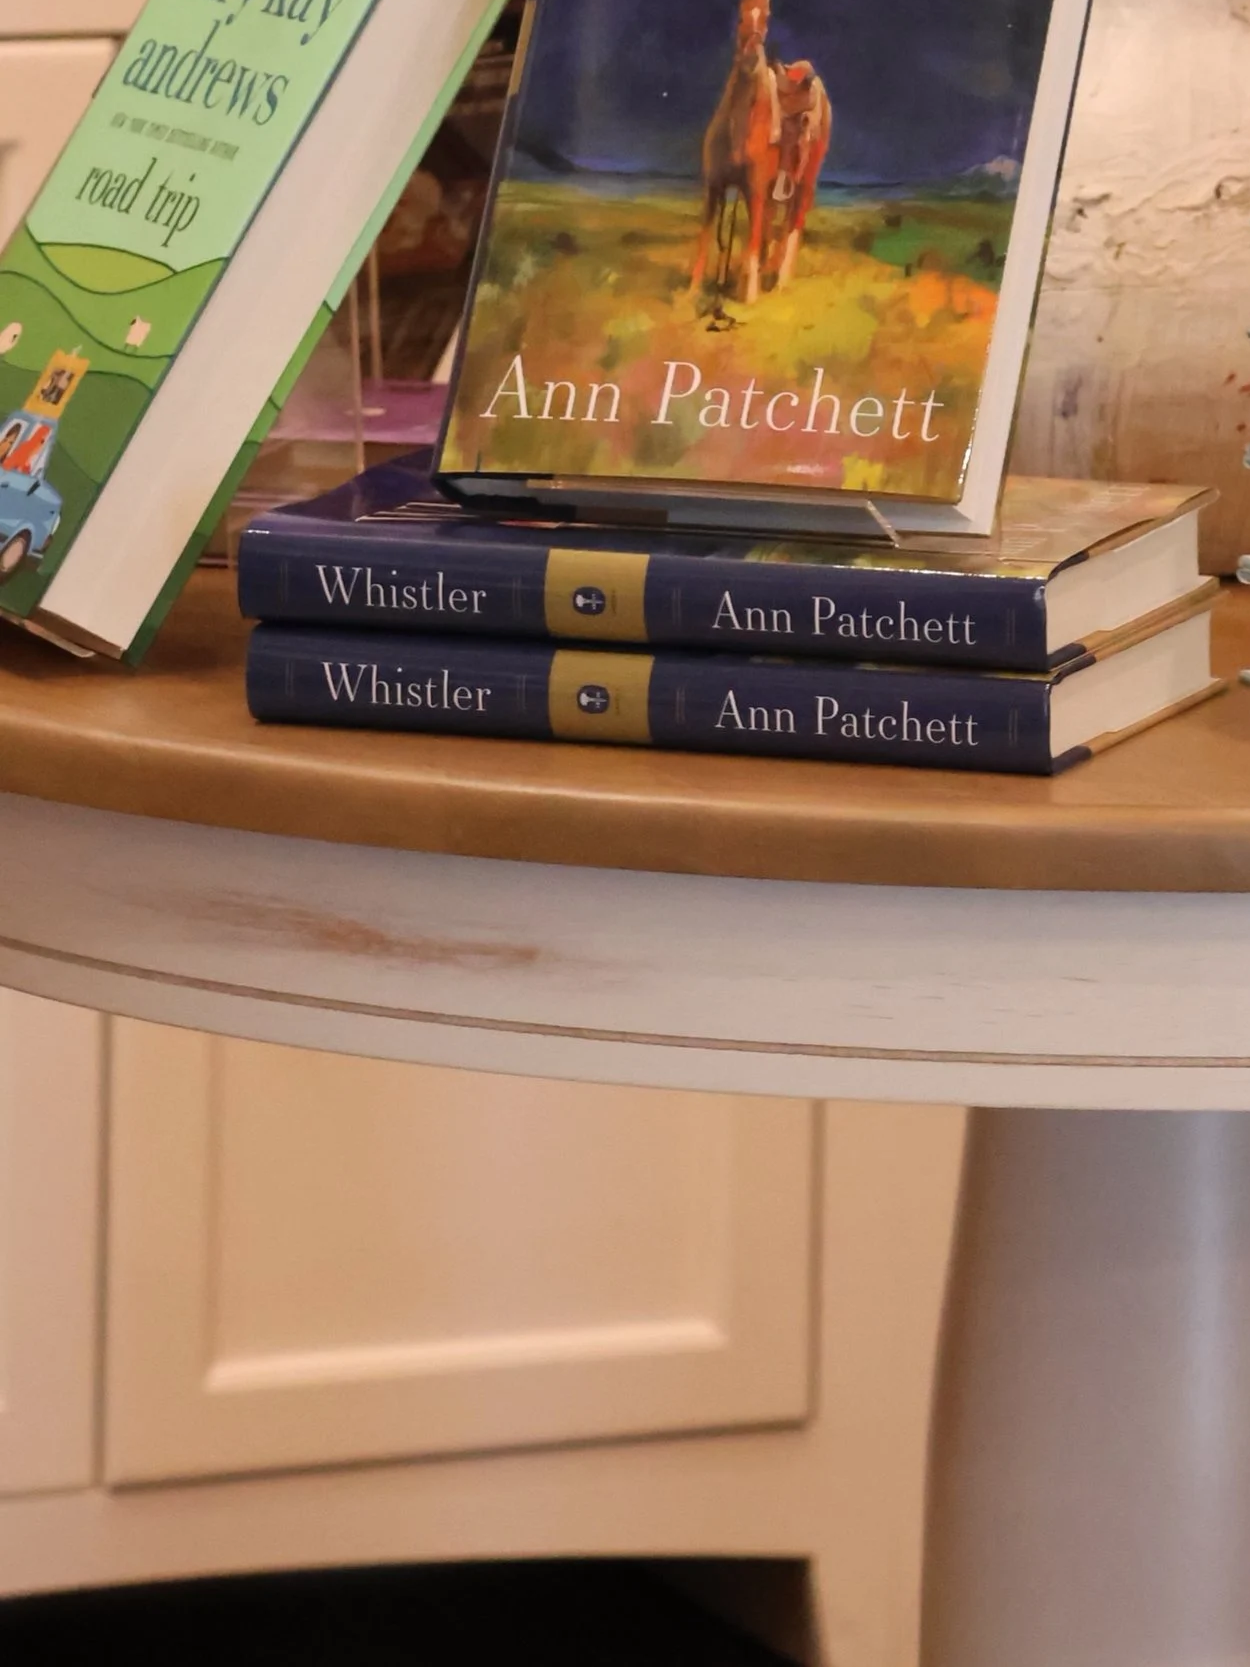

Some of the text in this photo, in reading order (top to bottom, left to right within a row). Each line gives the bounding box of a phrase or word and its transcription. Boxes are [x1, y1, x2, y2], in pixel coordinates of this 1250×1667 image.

[122, 19, 290, 126] andrews
[74, 156, 201, 248] road trip
[480, 354, 946, 443] Ann Patchett
[314, 563, 978, 647] Whistler Ann Patchett
[321, 660, 981, 748] Whistler Ann Patchett
